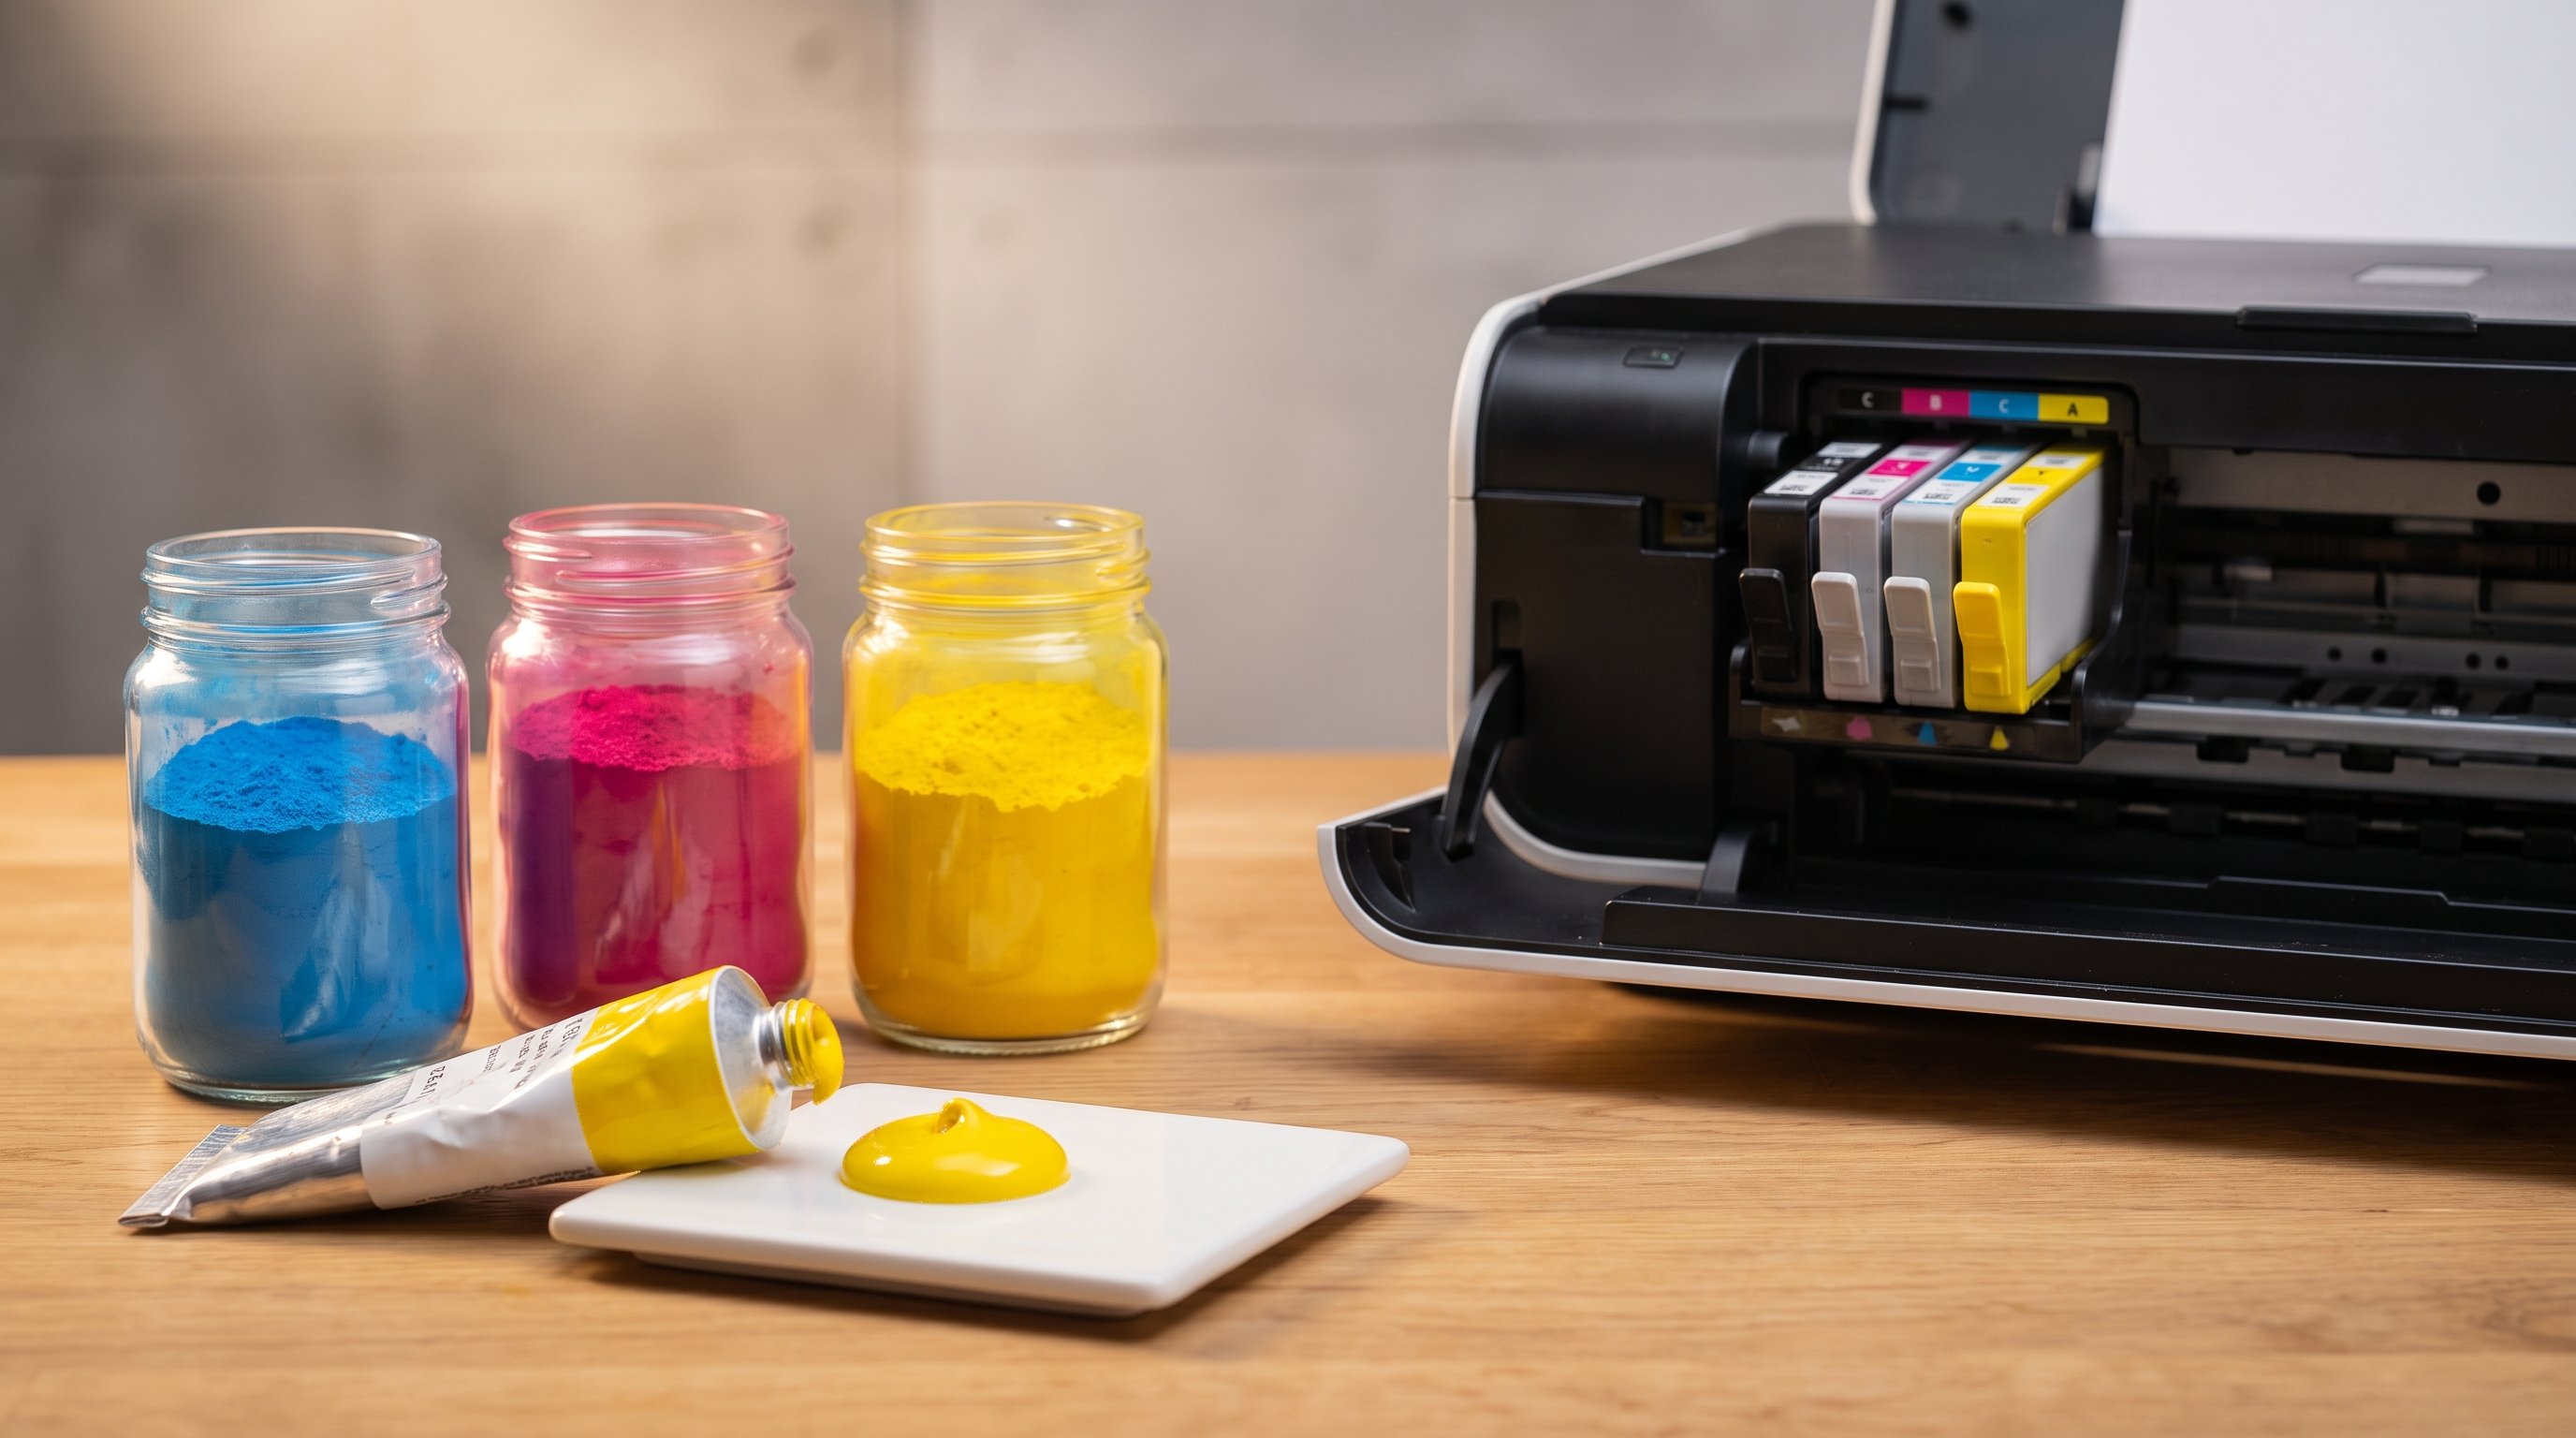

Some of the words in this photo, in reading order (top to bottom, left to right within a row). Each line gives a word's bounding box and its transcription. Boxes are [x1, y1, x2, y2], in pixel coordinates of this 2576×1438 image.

[1861, 391, 1874, 408] C
[1929, 394, 1942, 411] B
[1998, 399, 2010, 414] C
[2067, 403, 2078, 417] A
